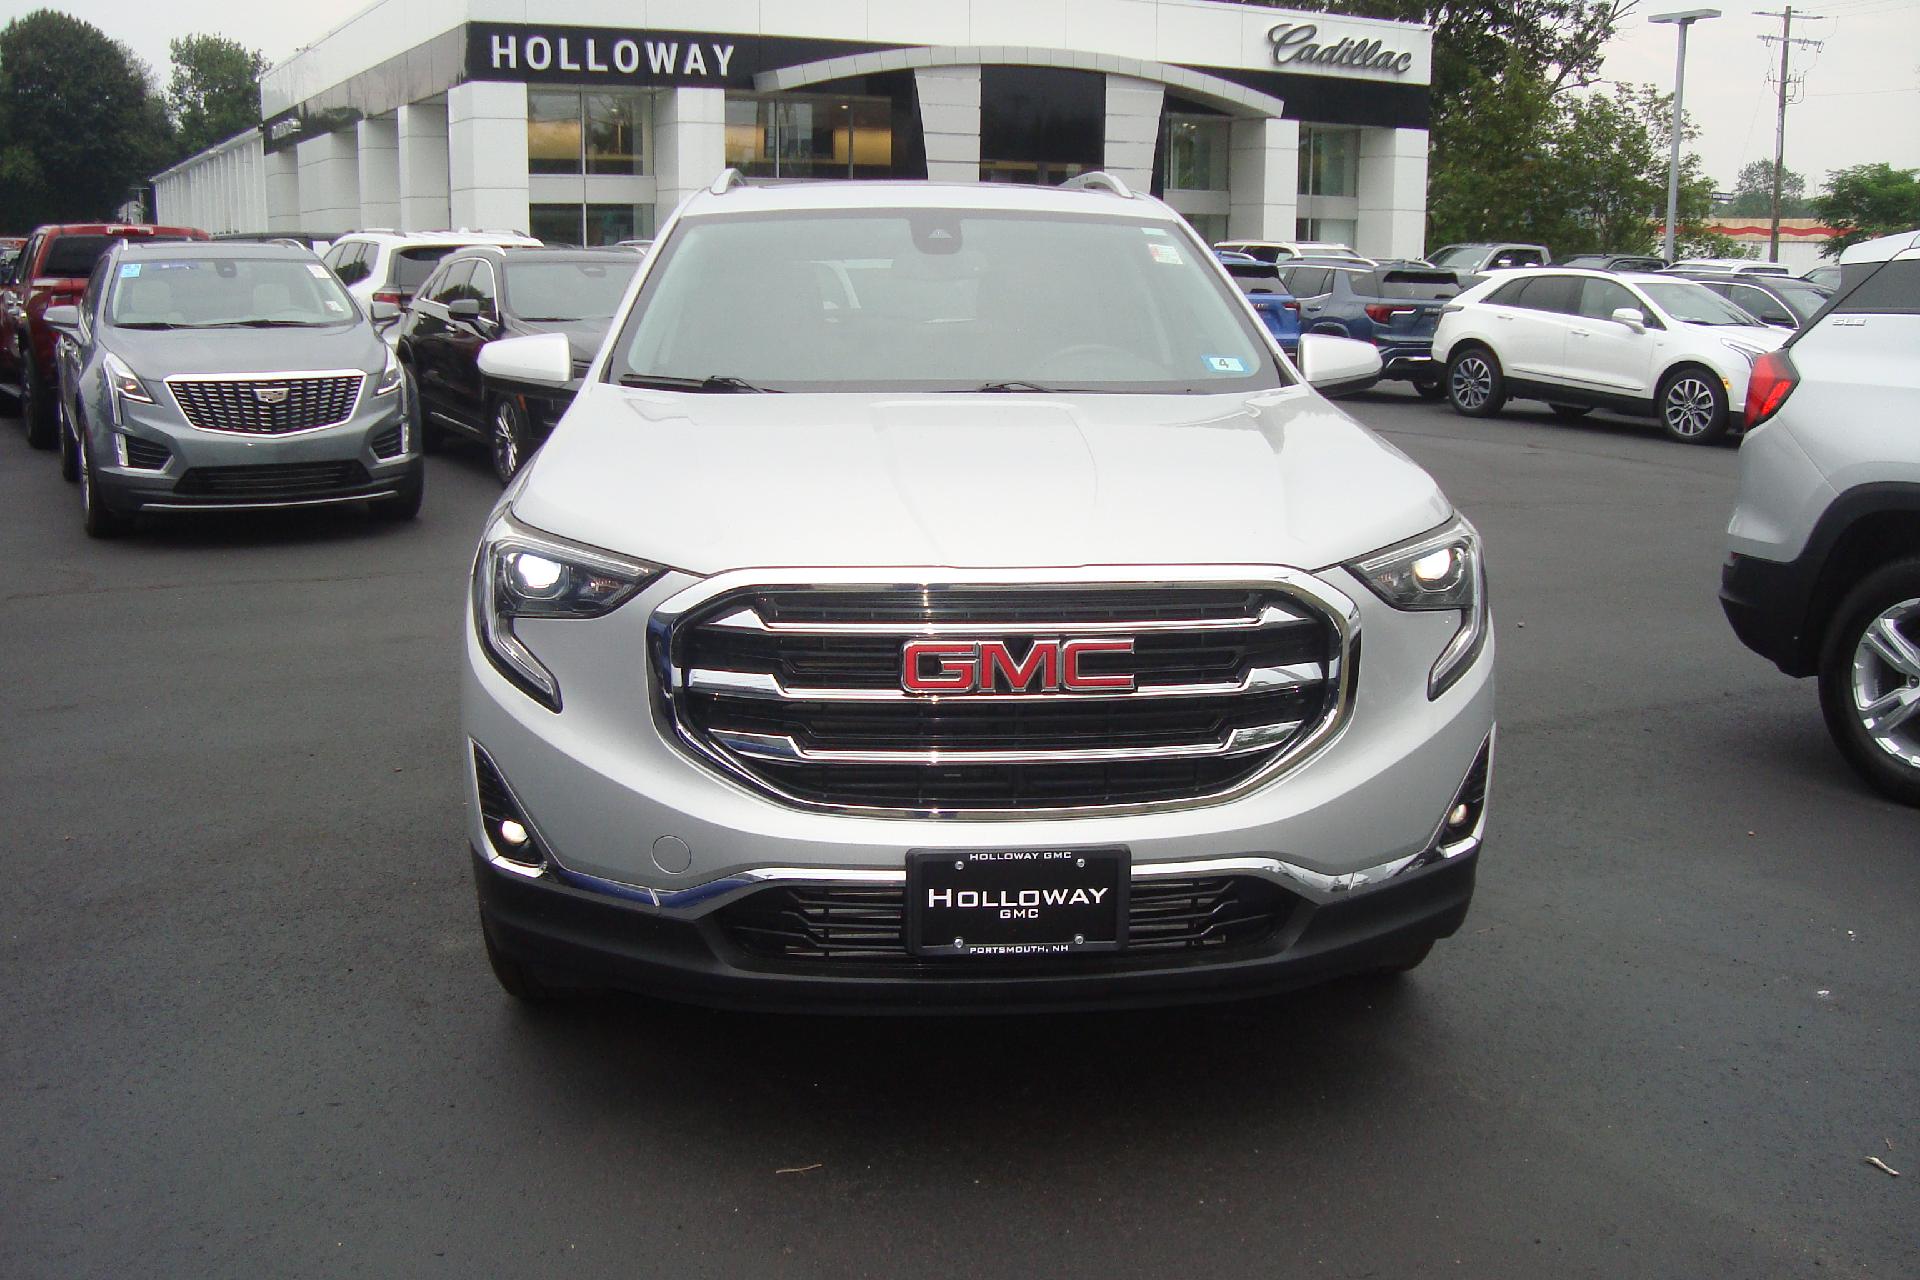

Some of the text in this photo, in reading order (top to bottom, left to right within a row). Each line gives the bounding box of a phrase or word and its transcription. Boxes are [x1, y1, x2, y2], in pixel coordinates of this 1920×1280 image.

[491, 34, 735, 77] HOLLOWAY
[1267, 23, 1412, 73] Cadillac
[1219, 358, 1229, 369] 4
[901, 638, 1135, 693] GMC
[969, 851, 1072, 861] HOLLOWAY GMC
[928, 887, 1109, 908] HOLLOWAY
[1000, 908, 1039, 919] GMC
[969, 944, 1069, 954] PORTSMOUTH, NH
